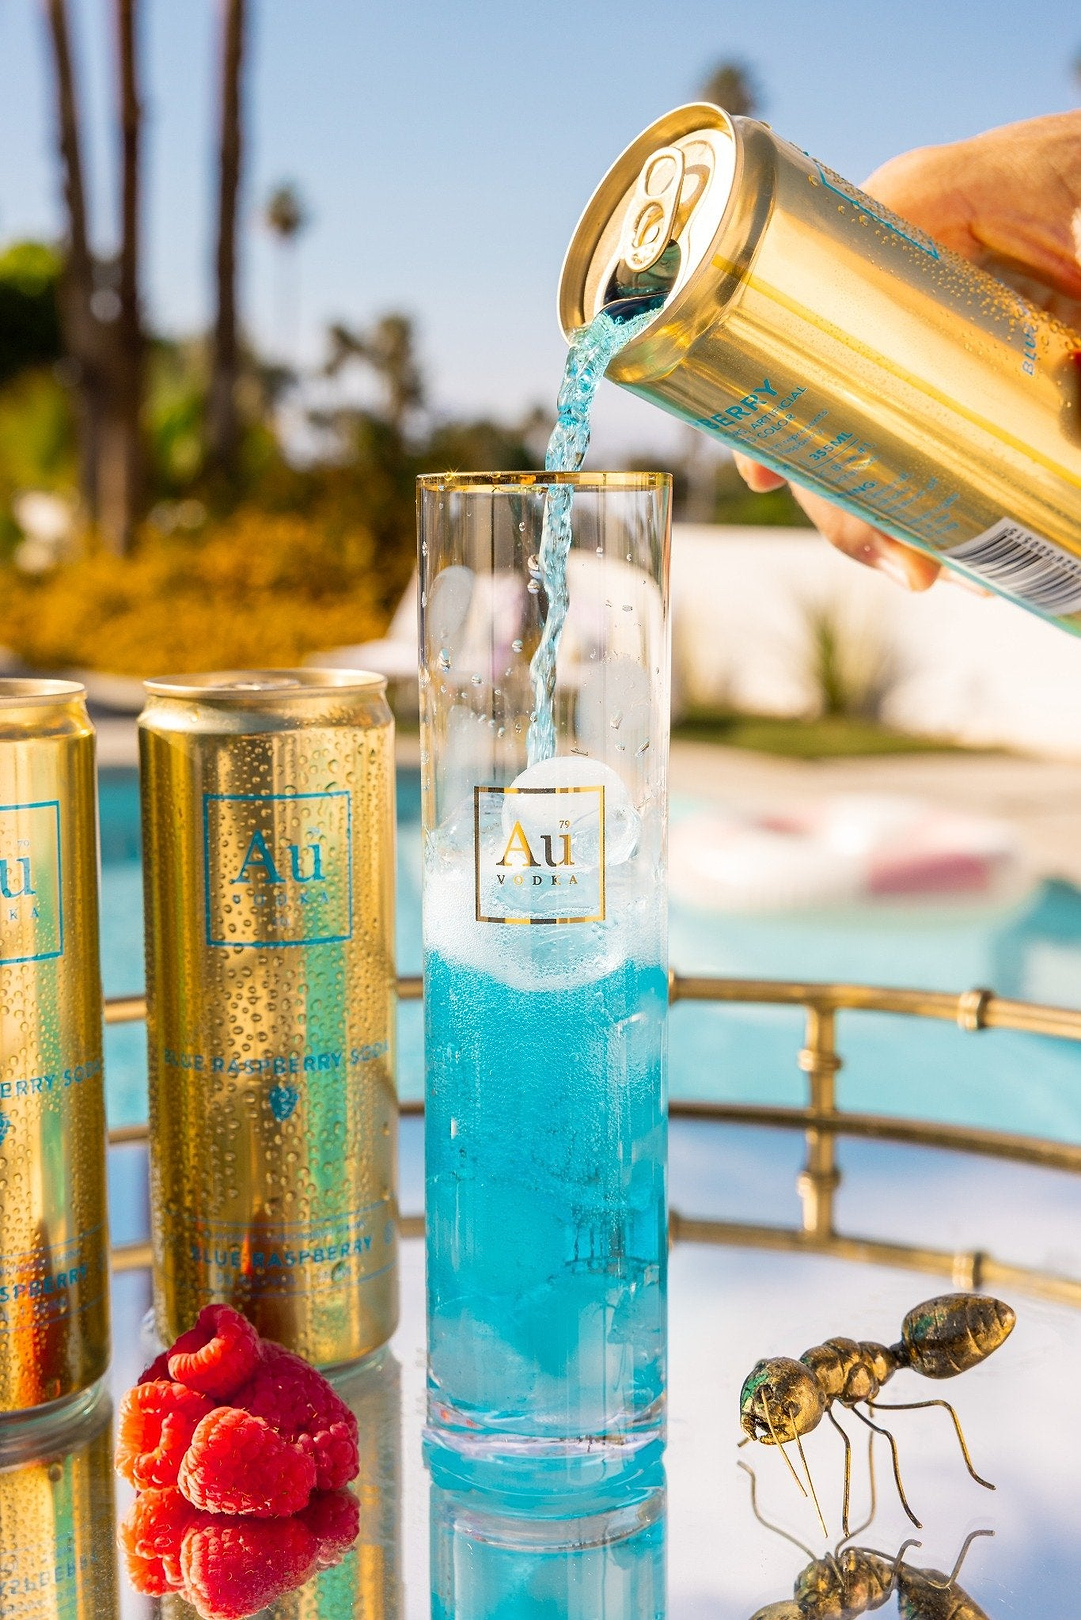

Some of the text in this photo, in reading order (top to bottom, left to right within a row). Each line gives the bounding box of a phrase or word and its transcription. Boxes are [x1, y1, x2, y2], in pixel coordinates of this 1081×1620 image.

[751, 386, 808, 430] ARTIFICIAL
[756, 413, 796, 439] COLOR
[808, 431, 854, 461] 355ML
[558, 820, 570, 829] 79
[228, 829, 325, 884] Au
[496, 820, 575, 868] Au
[496, 874, 579, 886] VODKA
[211, 1050, 342, 1075] RASPBERRY
[190, 1235, 372, 1269] BLUE RASPBERRY
